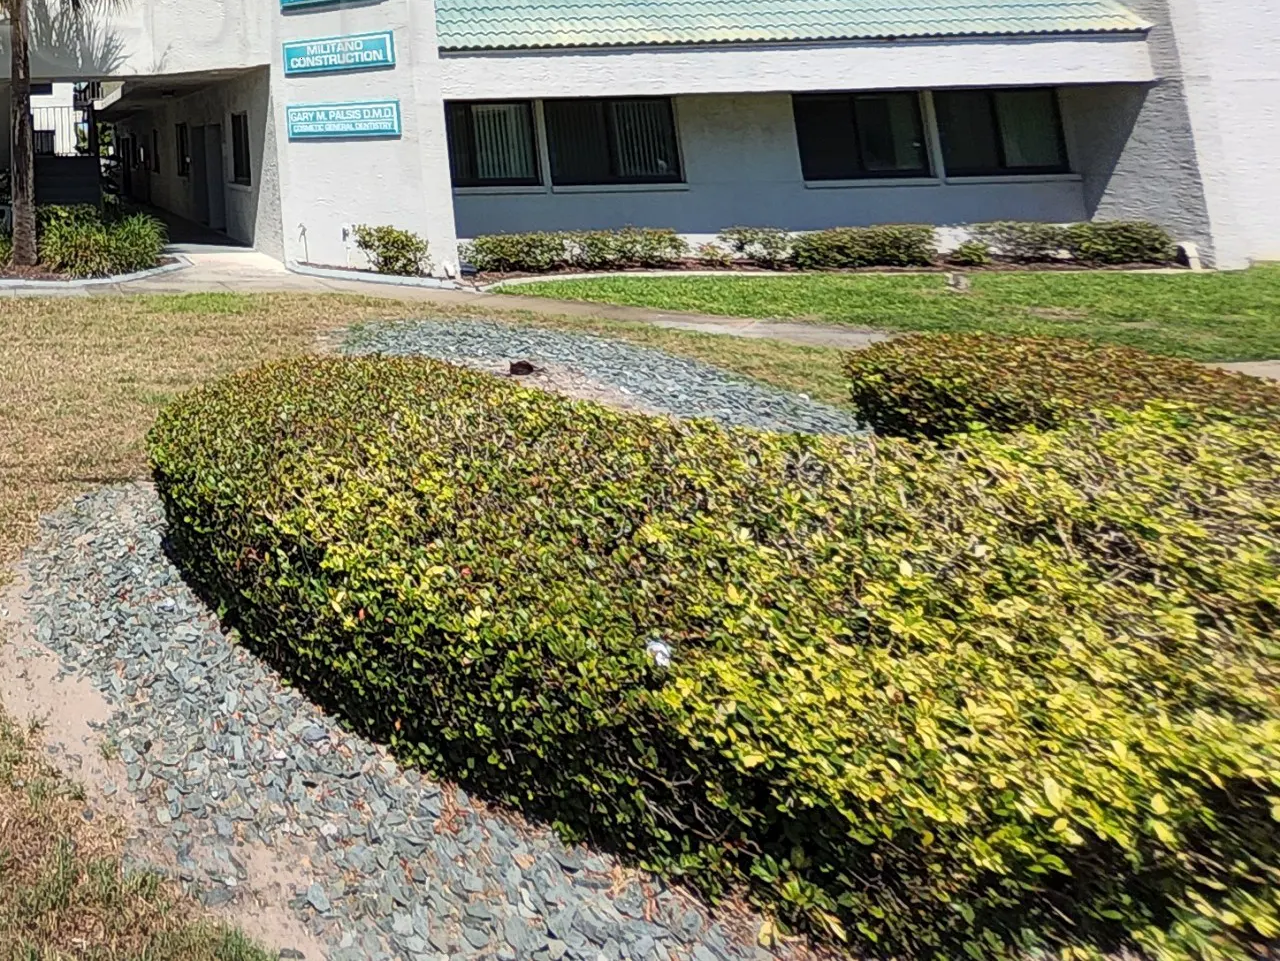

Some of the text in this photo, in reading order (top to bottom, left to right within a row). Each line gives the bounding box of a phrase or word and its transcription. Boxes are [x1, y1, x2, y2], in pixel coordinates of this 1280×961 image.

[306, 40, 364, 56] MILITANO
[290, 49, 384, 69] CONSTRUCTION
[290, 111, 315, 122] GARY
[328, 109, 362, 120] PALSIS
[324, 122, 354, 132] GENERAL
[355, 121, 393, 131] DENTISTRY
